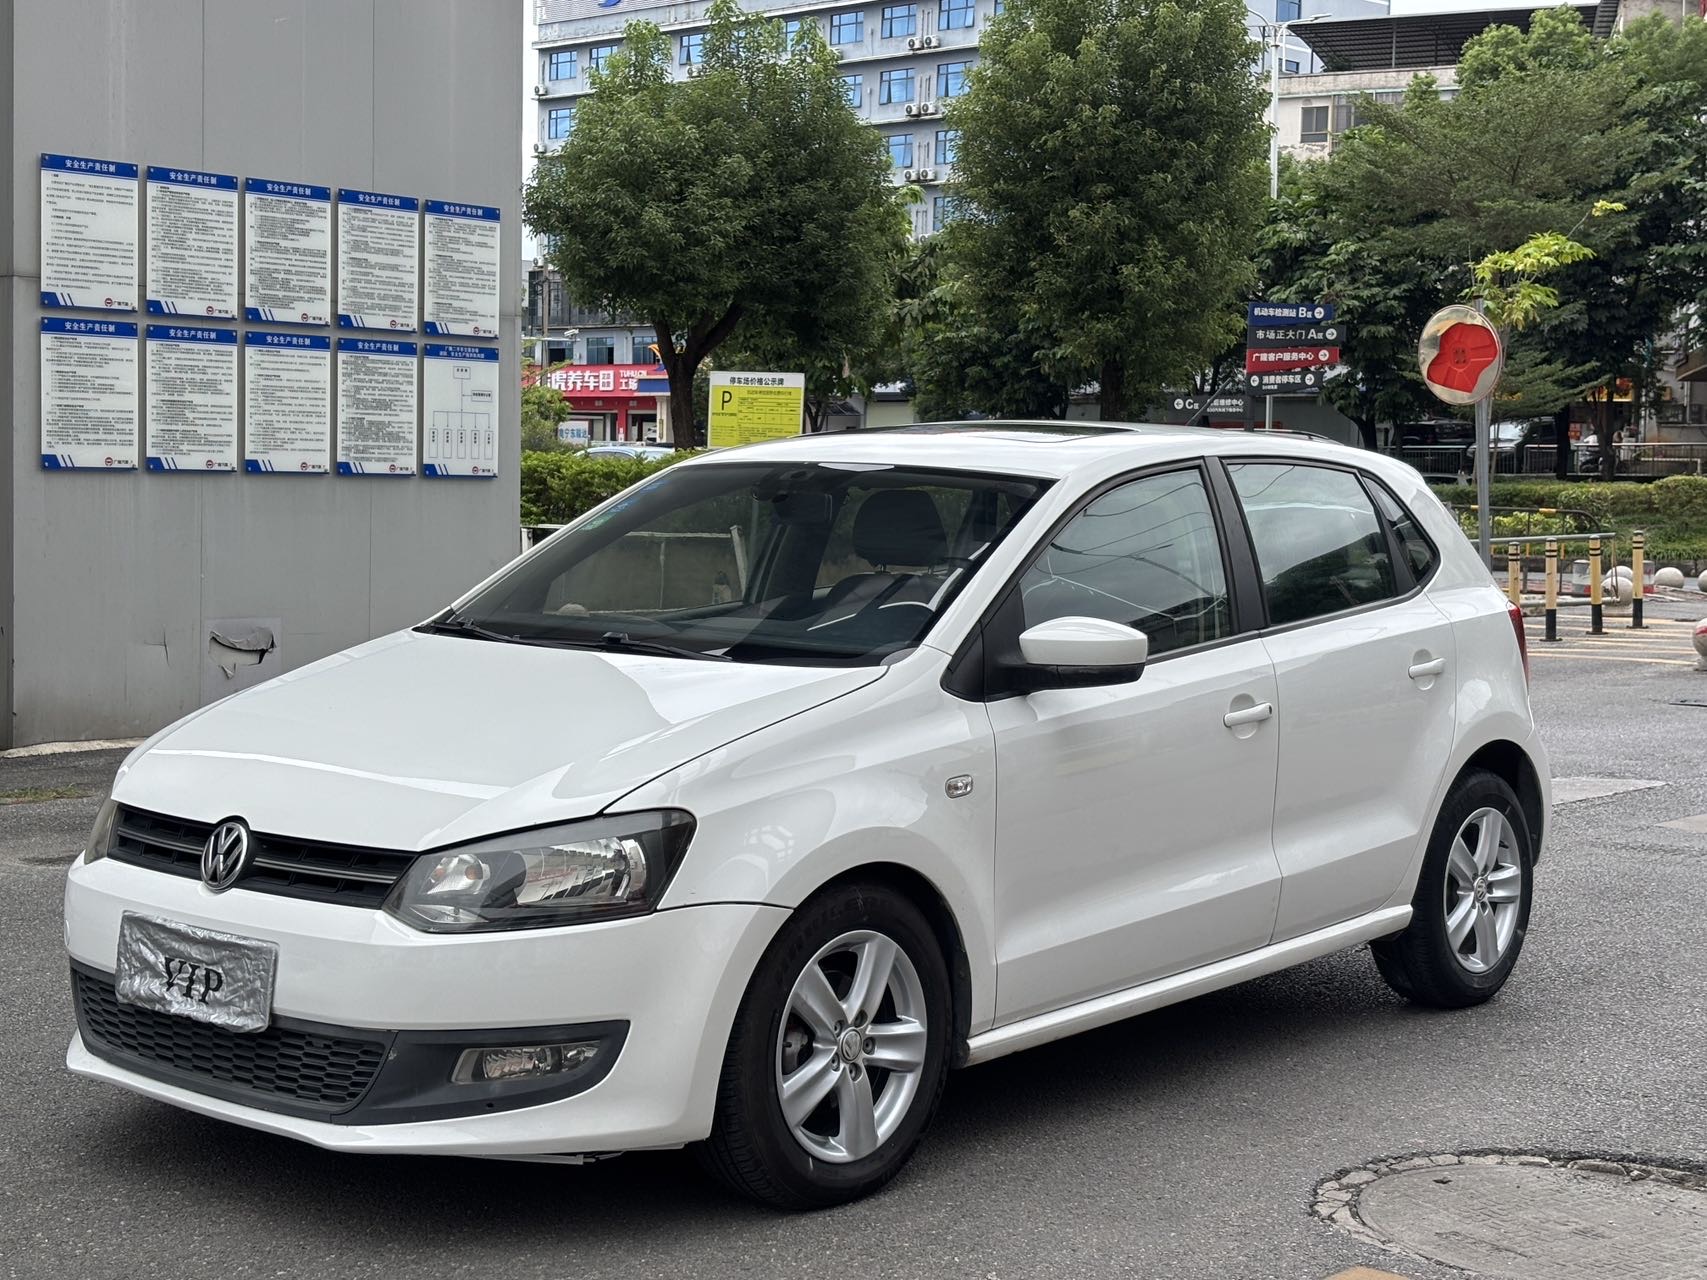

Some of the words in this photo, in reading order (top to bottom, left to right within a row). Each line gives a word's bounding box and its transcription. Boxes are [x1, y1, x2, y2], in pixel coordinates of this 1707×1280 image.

[65, 159, 116, 173] 安全生产责任制
[169, 171, 217, 185] 安全生产责任制
[266, 183, 311, 196] 安全生产责任制
[358, 194, 400, 206] 安全生产责任制
[443, 204, 483, 216] 安全生产责任制
[1253, 307, 1297, 317] 机动车检测站
[65, 321, 116, 333] 安全生产责任制
[169, 329, 217, 340] 安全生产责任制
[266, 335, 311, 346] 安全生产责任制
[1255, 329, 1305, 340] 市场正大门
[357, 341, 400, 352] 安全生产责任制
[536, 370, 599, 391] 虎养车
[729, 376, 785, 386] 停车场价格公示牌
[1262, 374, 1302, 384] 消费者停车区
[721, 390, 733, 411] P
[164, 956, 224, 1005] VIP
